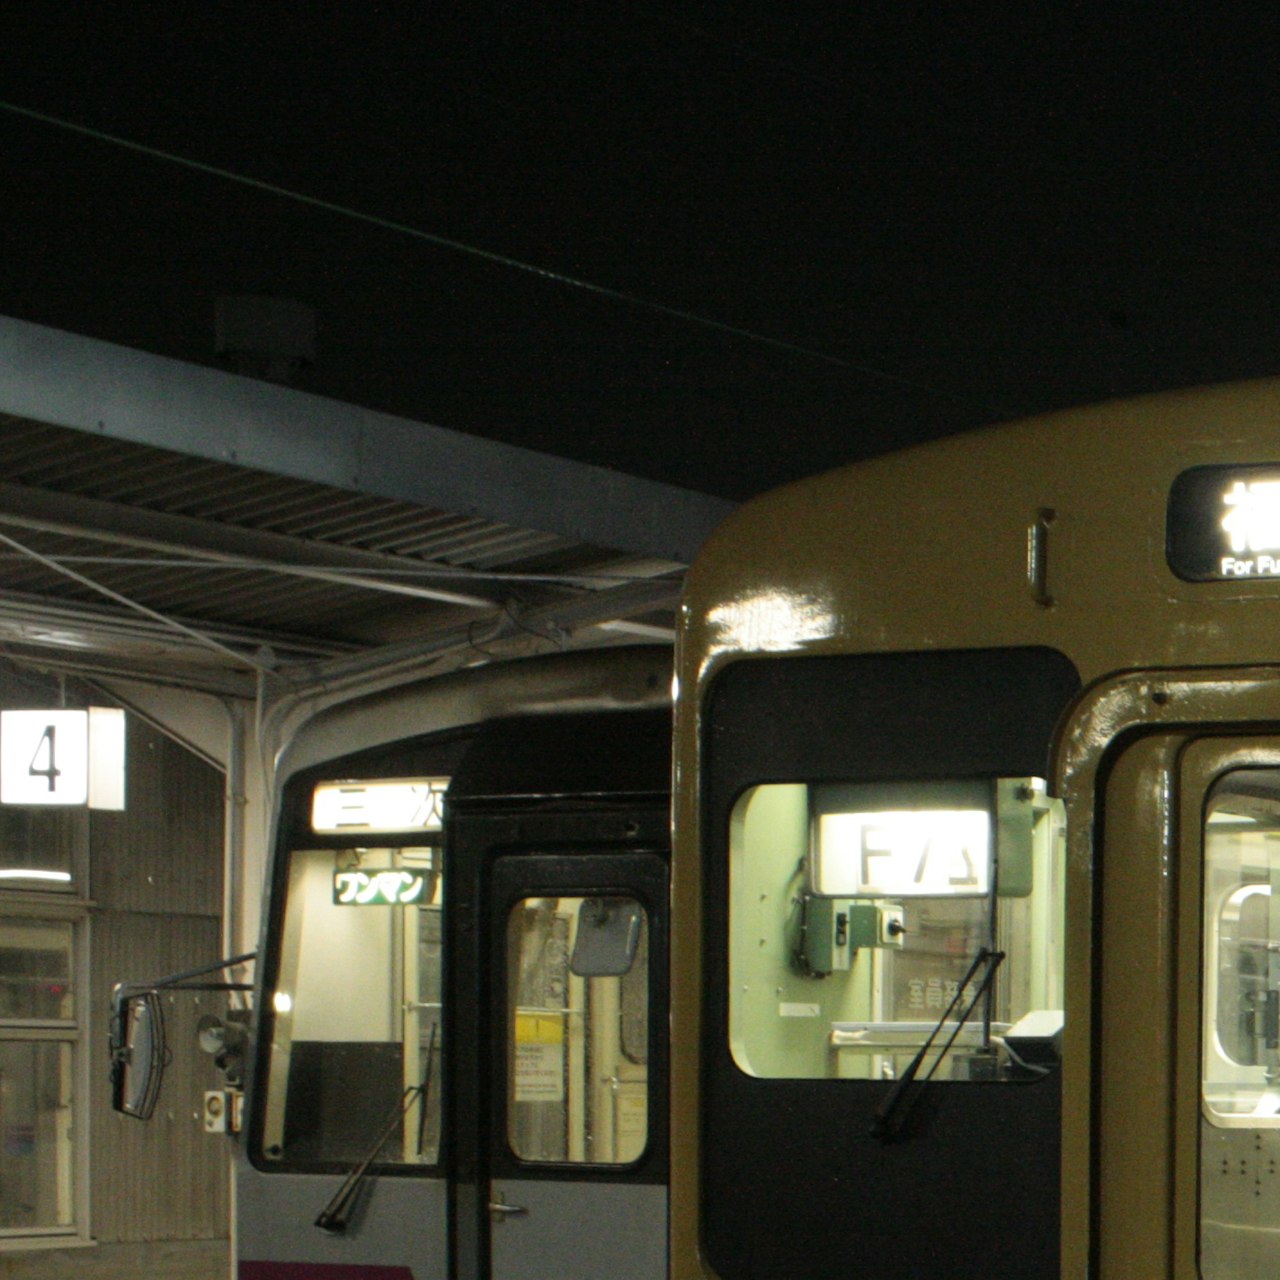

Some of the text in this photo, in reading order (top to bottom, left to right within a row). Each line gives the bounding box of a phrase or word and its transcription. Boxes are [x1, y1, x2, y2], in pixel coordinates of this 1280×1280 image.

[1221, 557, 1253, 575] For
[28, 724, 61, 793] 4
[335, 871, 423, 903] ワンマン
